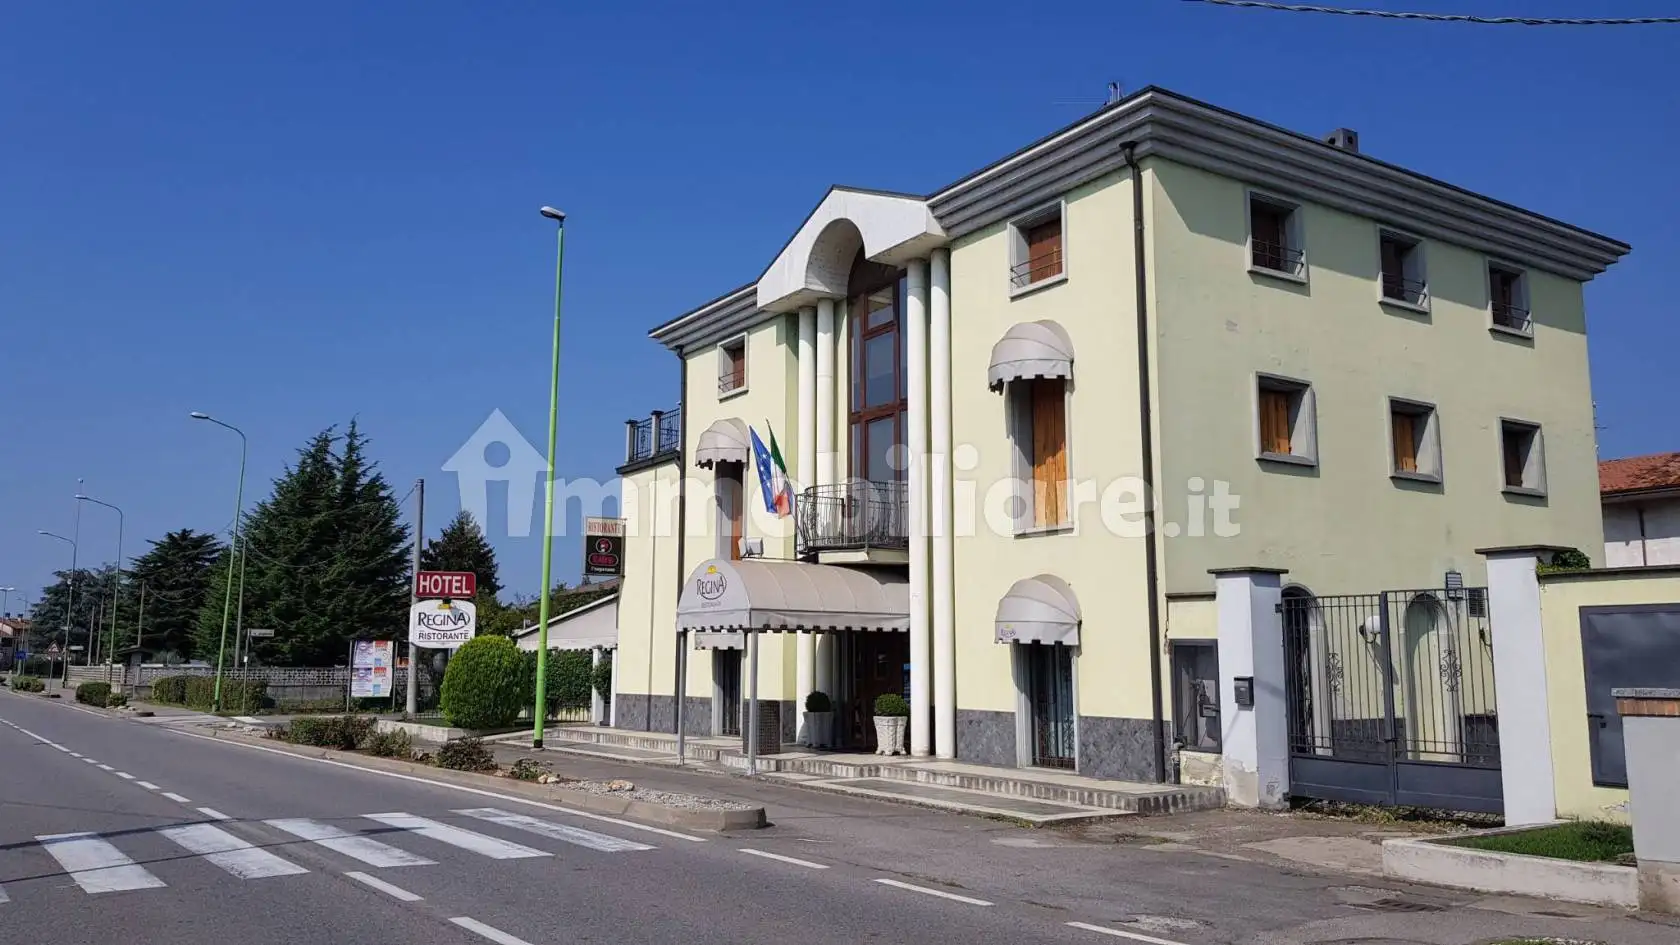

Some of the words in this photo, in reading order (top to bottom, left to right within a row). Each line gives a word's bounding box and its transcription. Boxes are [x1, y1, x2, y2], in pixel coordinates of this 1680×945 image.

[419, 575, 471, 594] HOTEL
[697, 576, 726, 595] REGINA
[418, 611, 468, 626] REGINA
[418, 632, 469, 640] RISTORANTE
